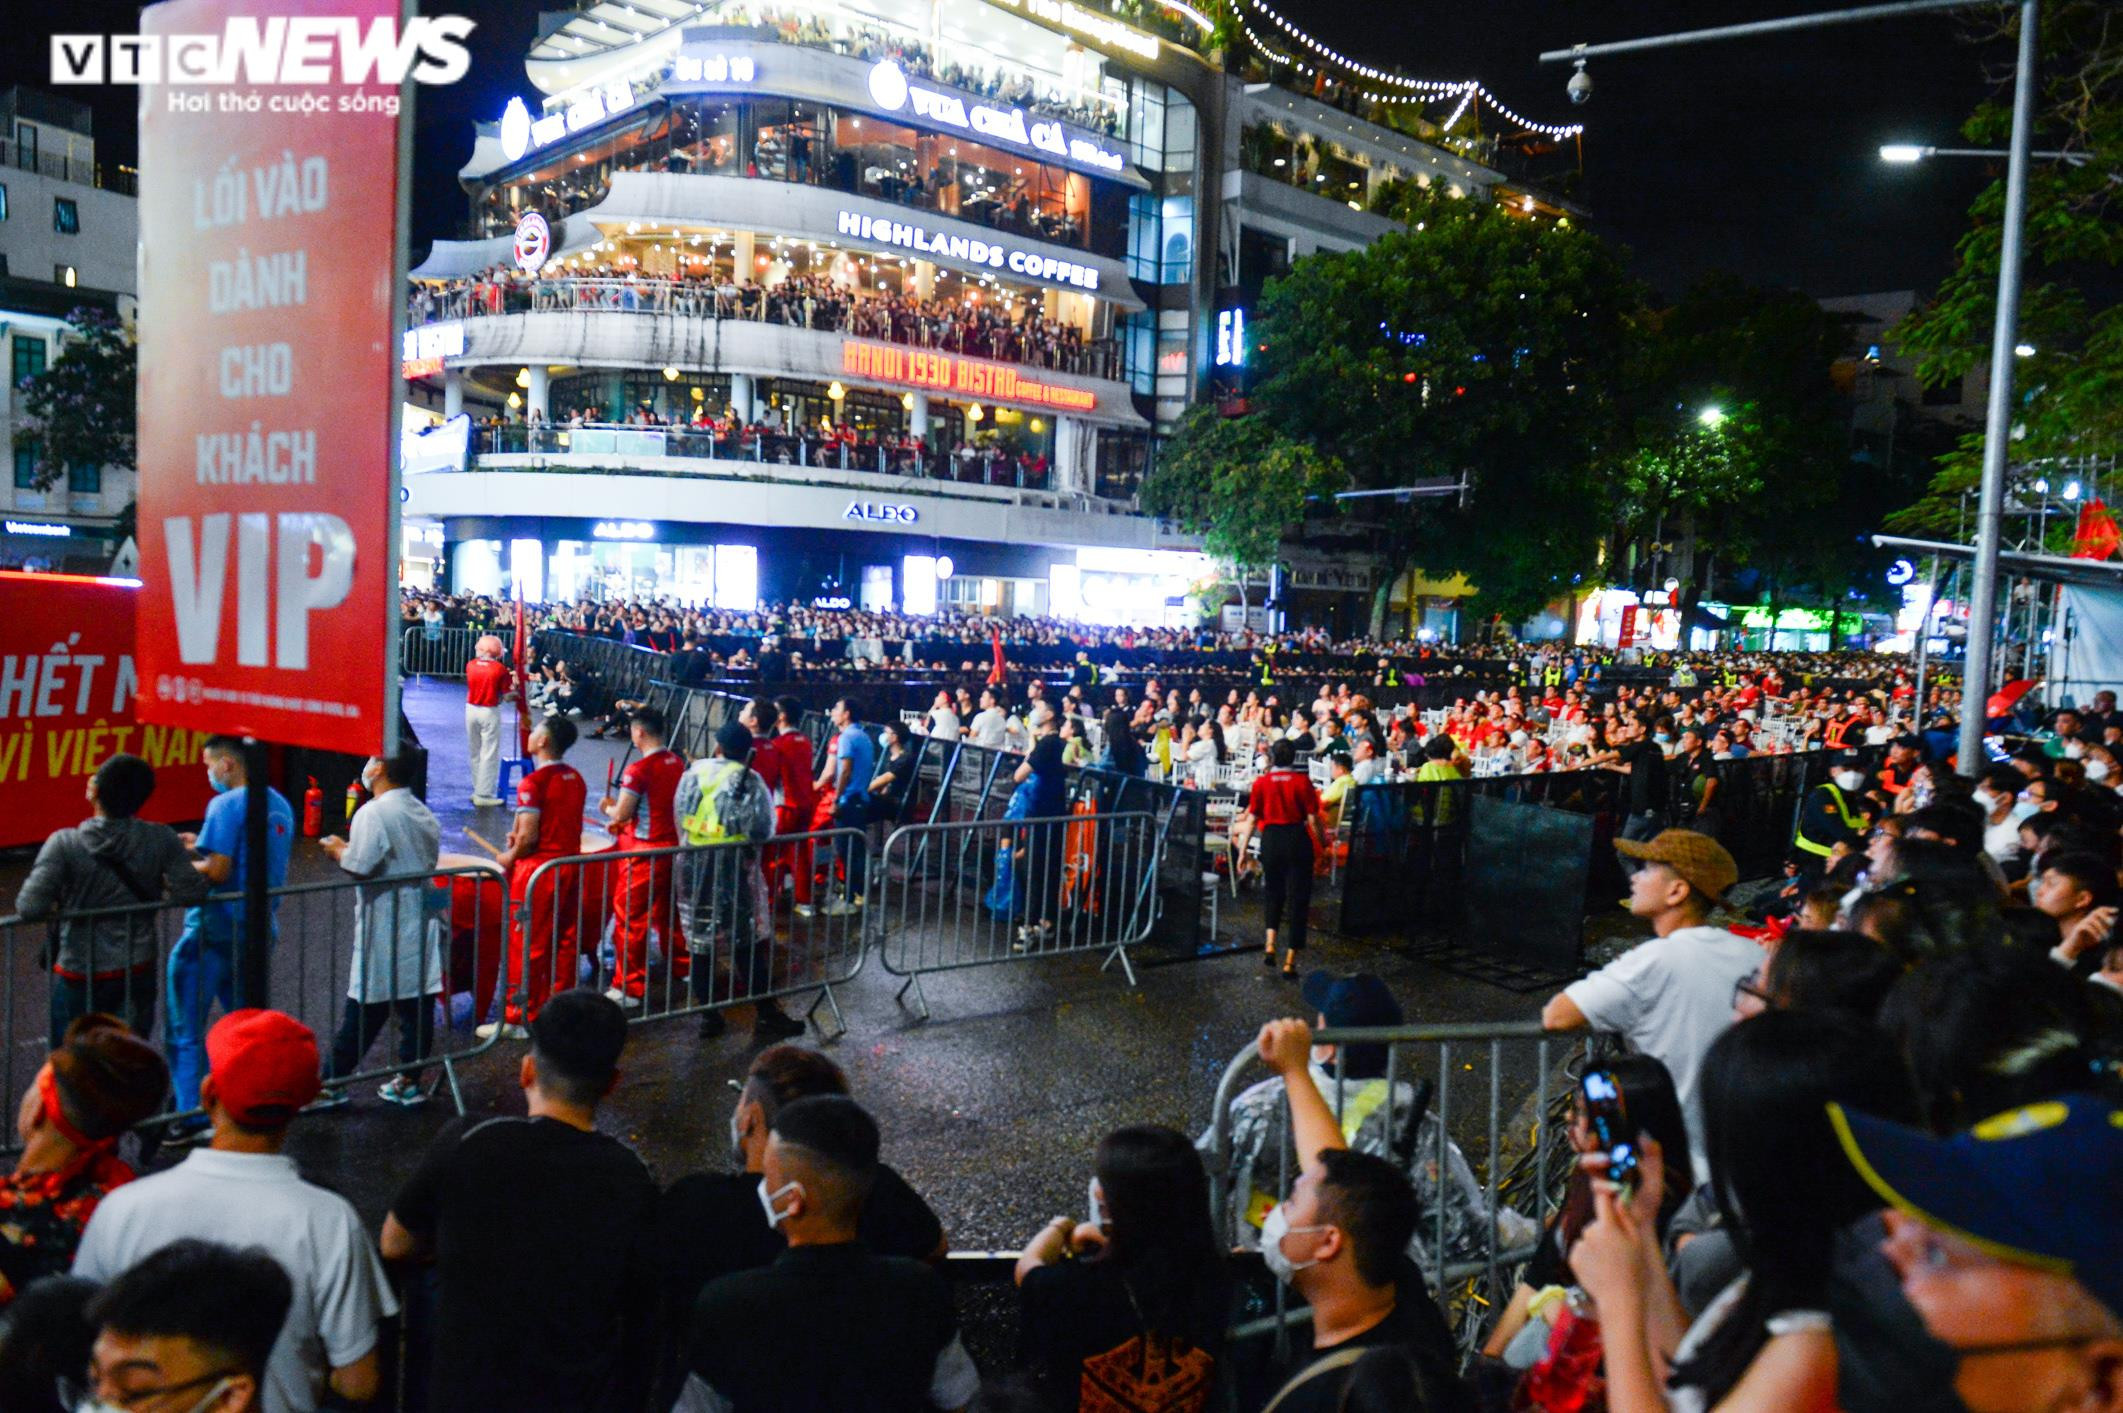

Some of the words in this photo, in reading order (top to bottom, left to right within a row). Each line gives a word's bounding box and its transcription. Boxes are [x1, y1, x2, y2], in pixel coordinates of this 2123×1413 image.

[194, 154, 247, 231] LỐI
[255, 149, 329, 220] VÀO
[209, 247, 306, 315] DÀNH
[838, 211, 1004, 268] HIGHLANDS
[1008, 250, 1099, 290] COFFEE
[219, 341, 293, 397] CHO
[843, 341, 902, 379] HANOI
[908, 350, 951, 389] 1930
[957, 358, 1016, 399] BISTRO
[196, 421, 316, 485] KHÁCH
[842, 500, 919, 524] ALDO
[163, 511, 356, 671] VIP
[0, 631, 105, 718] HẾT
